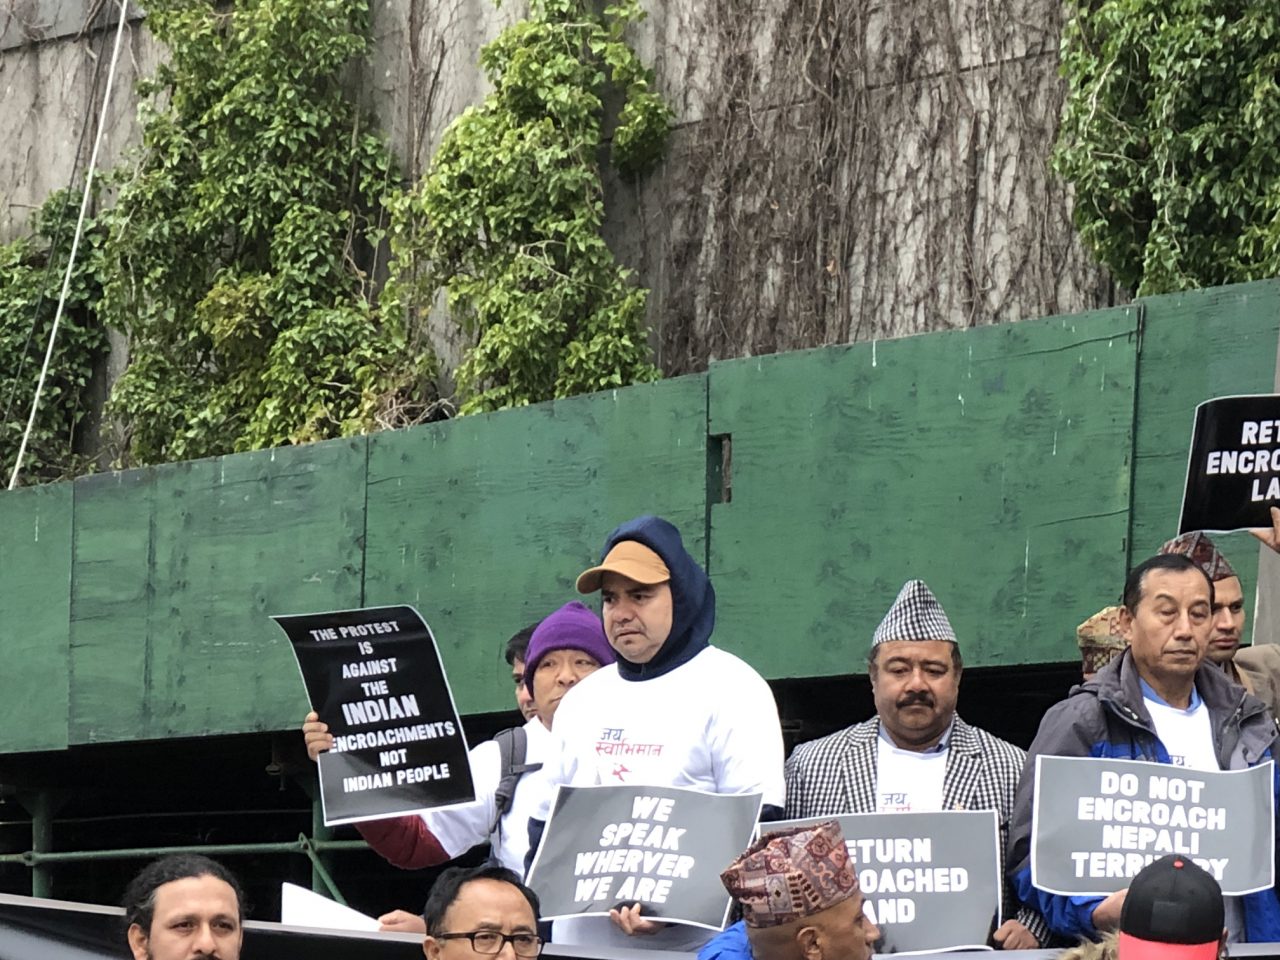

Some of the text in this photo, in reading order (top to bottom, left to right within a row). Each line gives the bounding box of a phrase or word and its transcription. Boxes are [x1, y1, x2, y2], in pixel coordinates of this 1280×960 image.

[310, 621, 400, 642] THE PROTEST
[358, 641, 374, 655] IS
[342, 658, 397, 679] AGAINST
[361, 680, 389, 697] THE
[341, 694, 420, 725] INDIAN
[329, 721, 456, 753] ENCROACHMENTS
[600, 728, 625, 741] जय
[379, 749, 407, 767] NOT
[343, 763, 450, 793] INDIAN PEOPLE
[1100, 771, 1205, 803] DO NOT
[631, 796, 675, 821] WE
[1077, 797, 1227, 830] ENCROACH
[599, 822, 687, 850] SPEAK
[1102, 824, 1199, 854] NEPALI
[574, 849, 695, 879] WHERVER
[844, 838, 932, 864] ETURN
[574, 876, 673, 904] WE ARE
[858, 867, 969, 894] OACHED
[862, 898, 916, 925] AND
